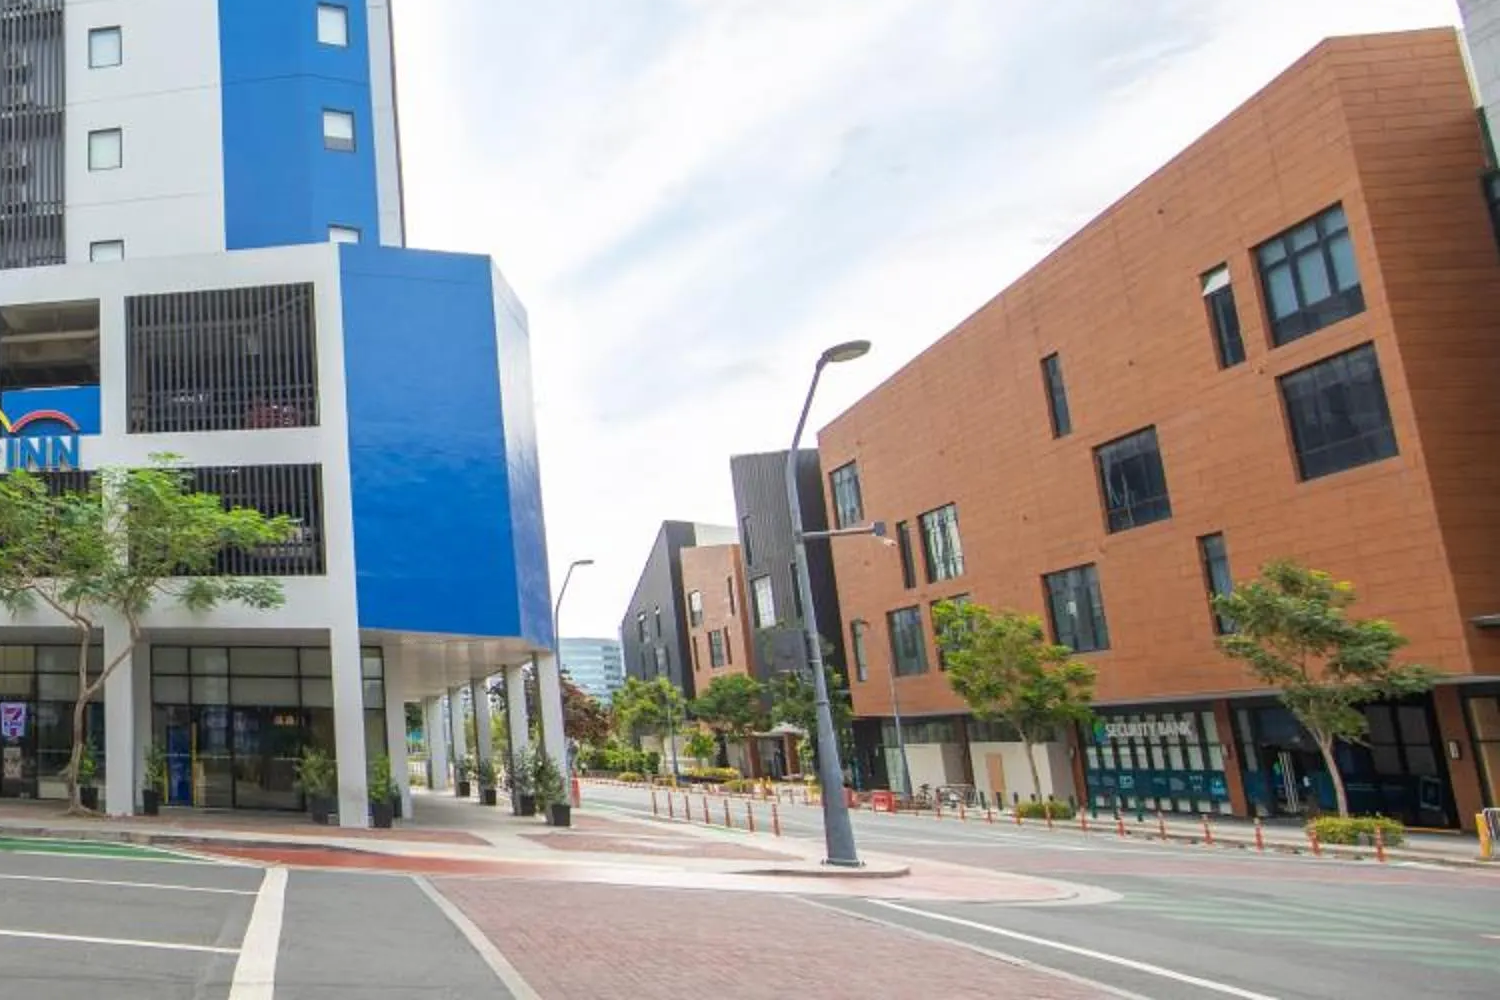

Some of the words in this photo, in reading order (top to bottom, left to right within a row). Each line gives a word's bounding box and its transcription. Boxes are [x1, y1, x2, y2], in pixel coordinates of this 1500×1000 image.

[6, 435, 80, 470] INN
[1105, 722, 1156, 737] SECURITY
[1158, 720, 1192, 737] BANK
